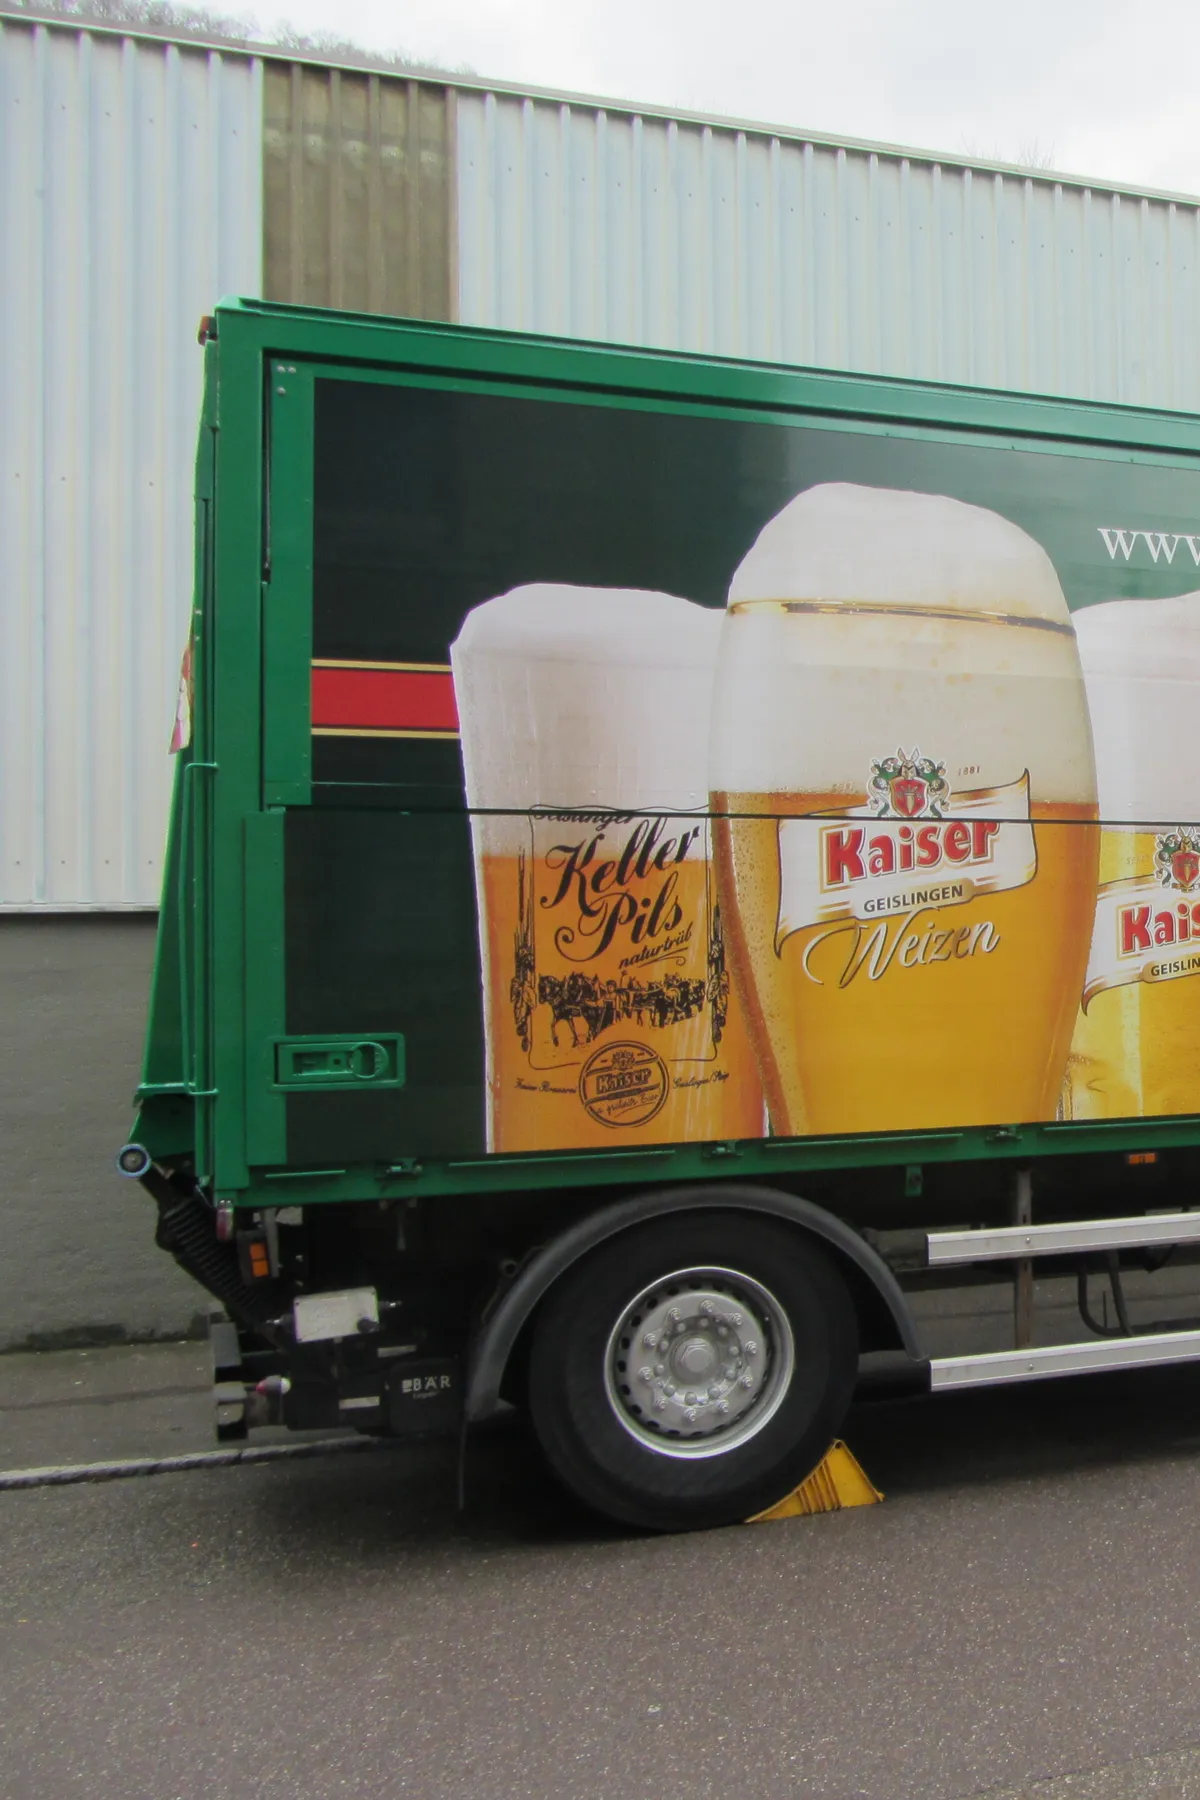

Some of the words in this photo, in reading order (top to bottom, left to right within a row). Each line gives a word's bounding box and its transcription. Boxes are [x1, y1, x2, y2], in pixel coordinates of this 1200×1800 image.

[957, 765, 981, 777] 1881
[540, 816, 700, 918] Keller
[824, 821, 1001, 887] Kaiser
[555, 871, 683, 963] Pils
[863, 884, 964, 913] GEISLINGEN
[618, 921, 693, 970] naturtrüb
[802, 907, 1001, 990] Weizen
[597, 1068, 652, 1094] Kaiser
[412, 1375, 452, 1391] BÄR
